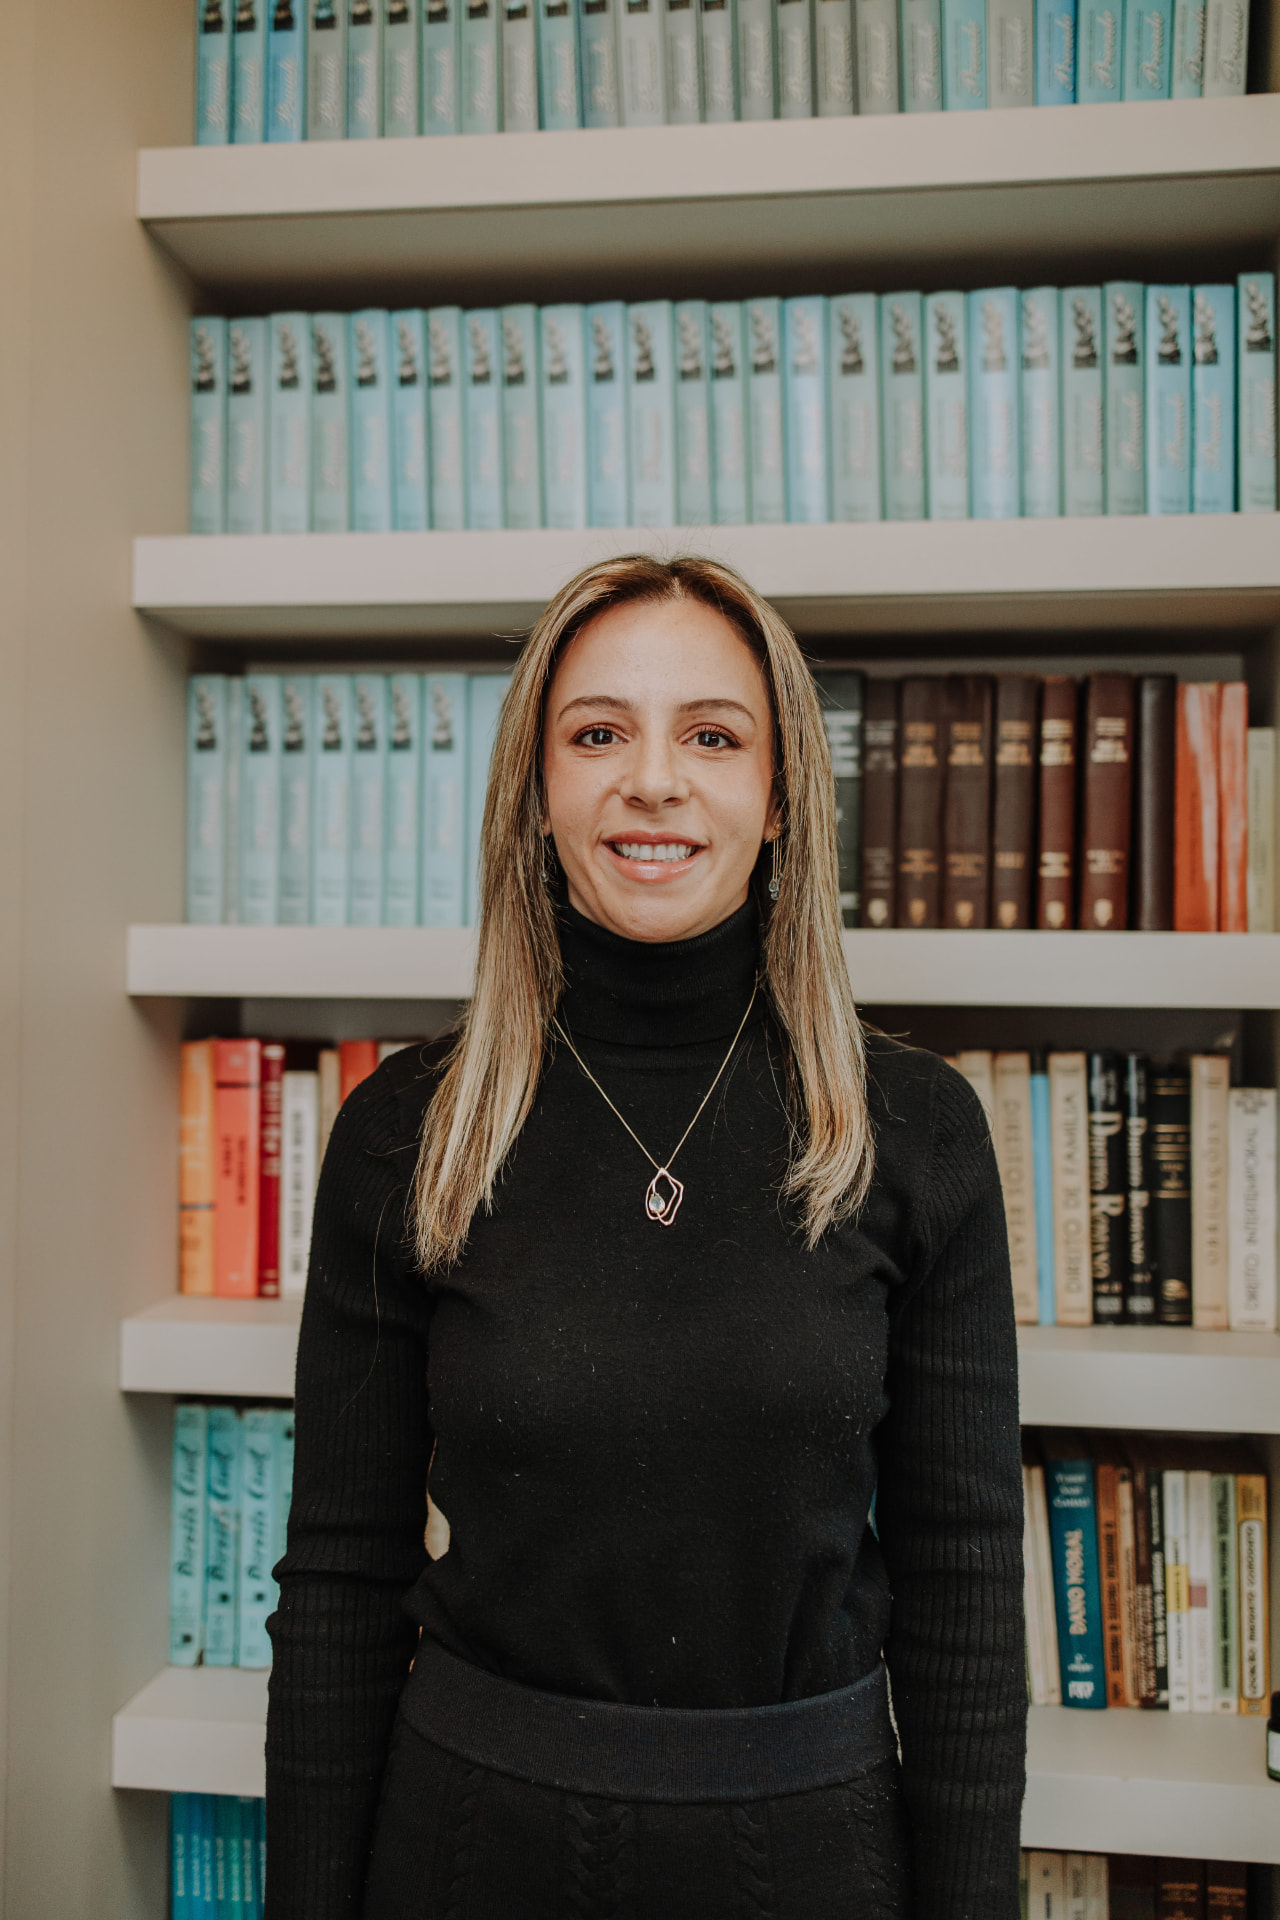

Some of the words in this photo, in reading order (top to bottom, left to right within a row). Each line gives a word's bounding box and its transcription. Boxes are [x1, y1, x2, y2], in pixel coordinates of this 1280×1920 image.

[1063, 1186, 1081, 1210] DE
[1063, 1218, 1083, 1295] DIREITO
[1065, 1528, 1085, 1586] MORAL
[1068, 1586, 1088, 1635] DANO
